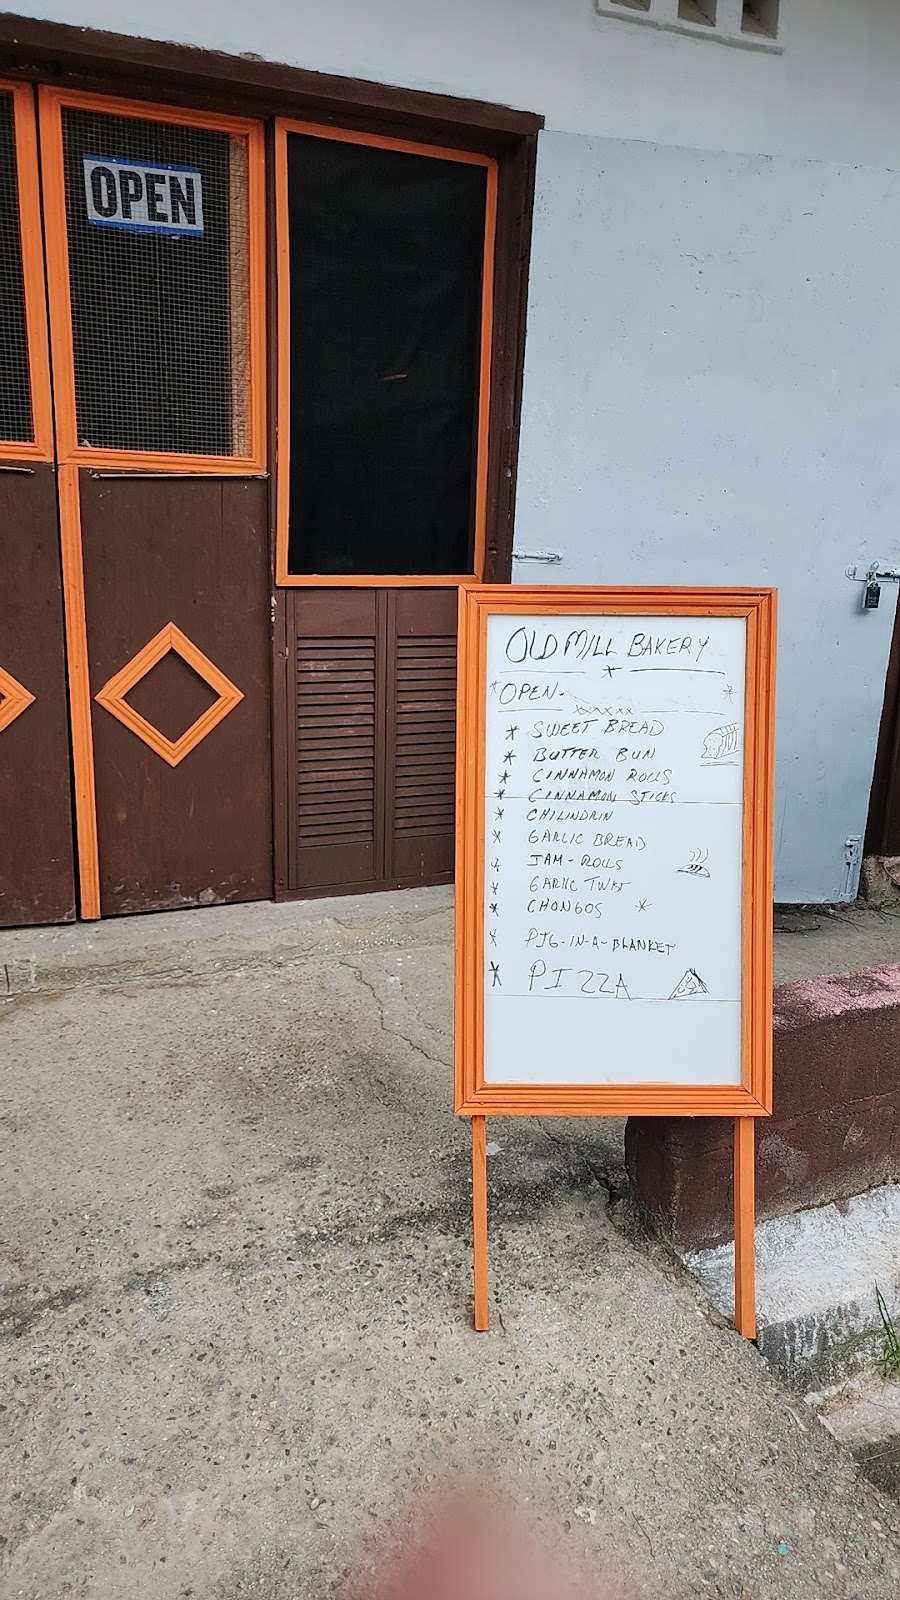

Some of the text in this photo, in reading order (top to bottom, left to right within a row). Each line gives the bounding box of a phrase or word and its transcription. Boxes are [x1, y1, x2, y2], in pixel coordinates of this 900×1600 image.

[90, 166, 196, 225] OPEN
[505, 626, 710, 663] OLD MILL BAKERY
[531, 719, 665, 738] SWEET BREAD
[533, 747, 656, 762] BUTTER BUN
[532, 768, 673, 785] CINNAMON ROLLS
[528, 788, 677, 806] CINNAMON STICKS
[526, 807, 614, 822] CHILINDRIN
[528, 829, 647, 850] GARLIC BREAD
[526, 854, 563, 867] JAM
[580, 854, 624, 871] ROLLS
[527, 898, 603, 918] CHONGOS
[528, 959, 632, 1001] PIZZA
